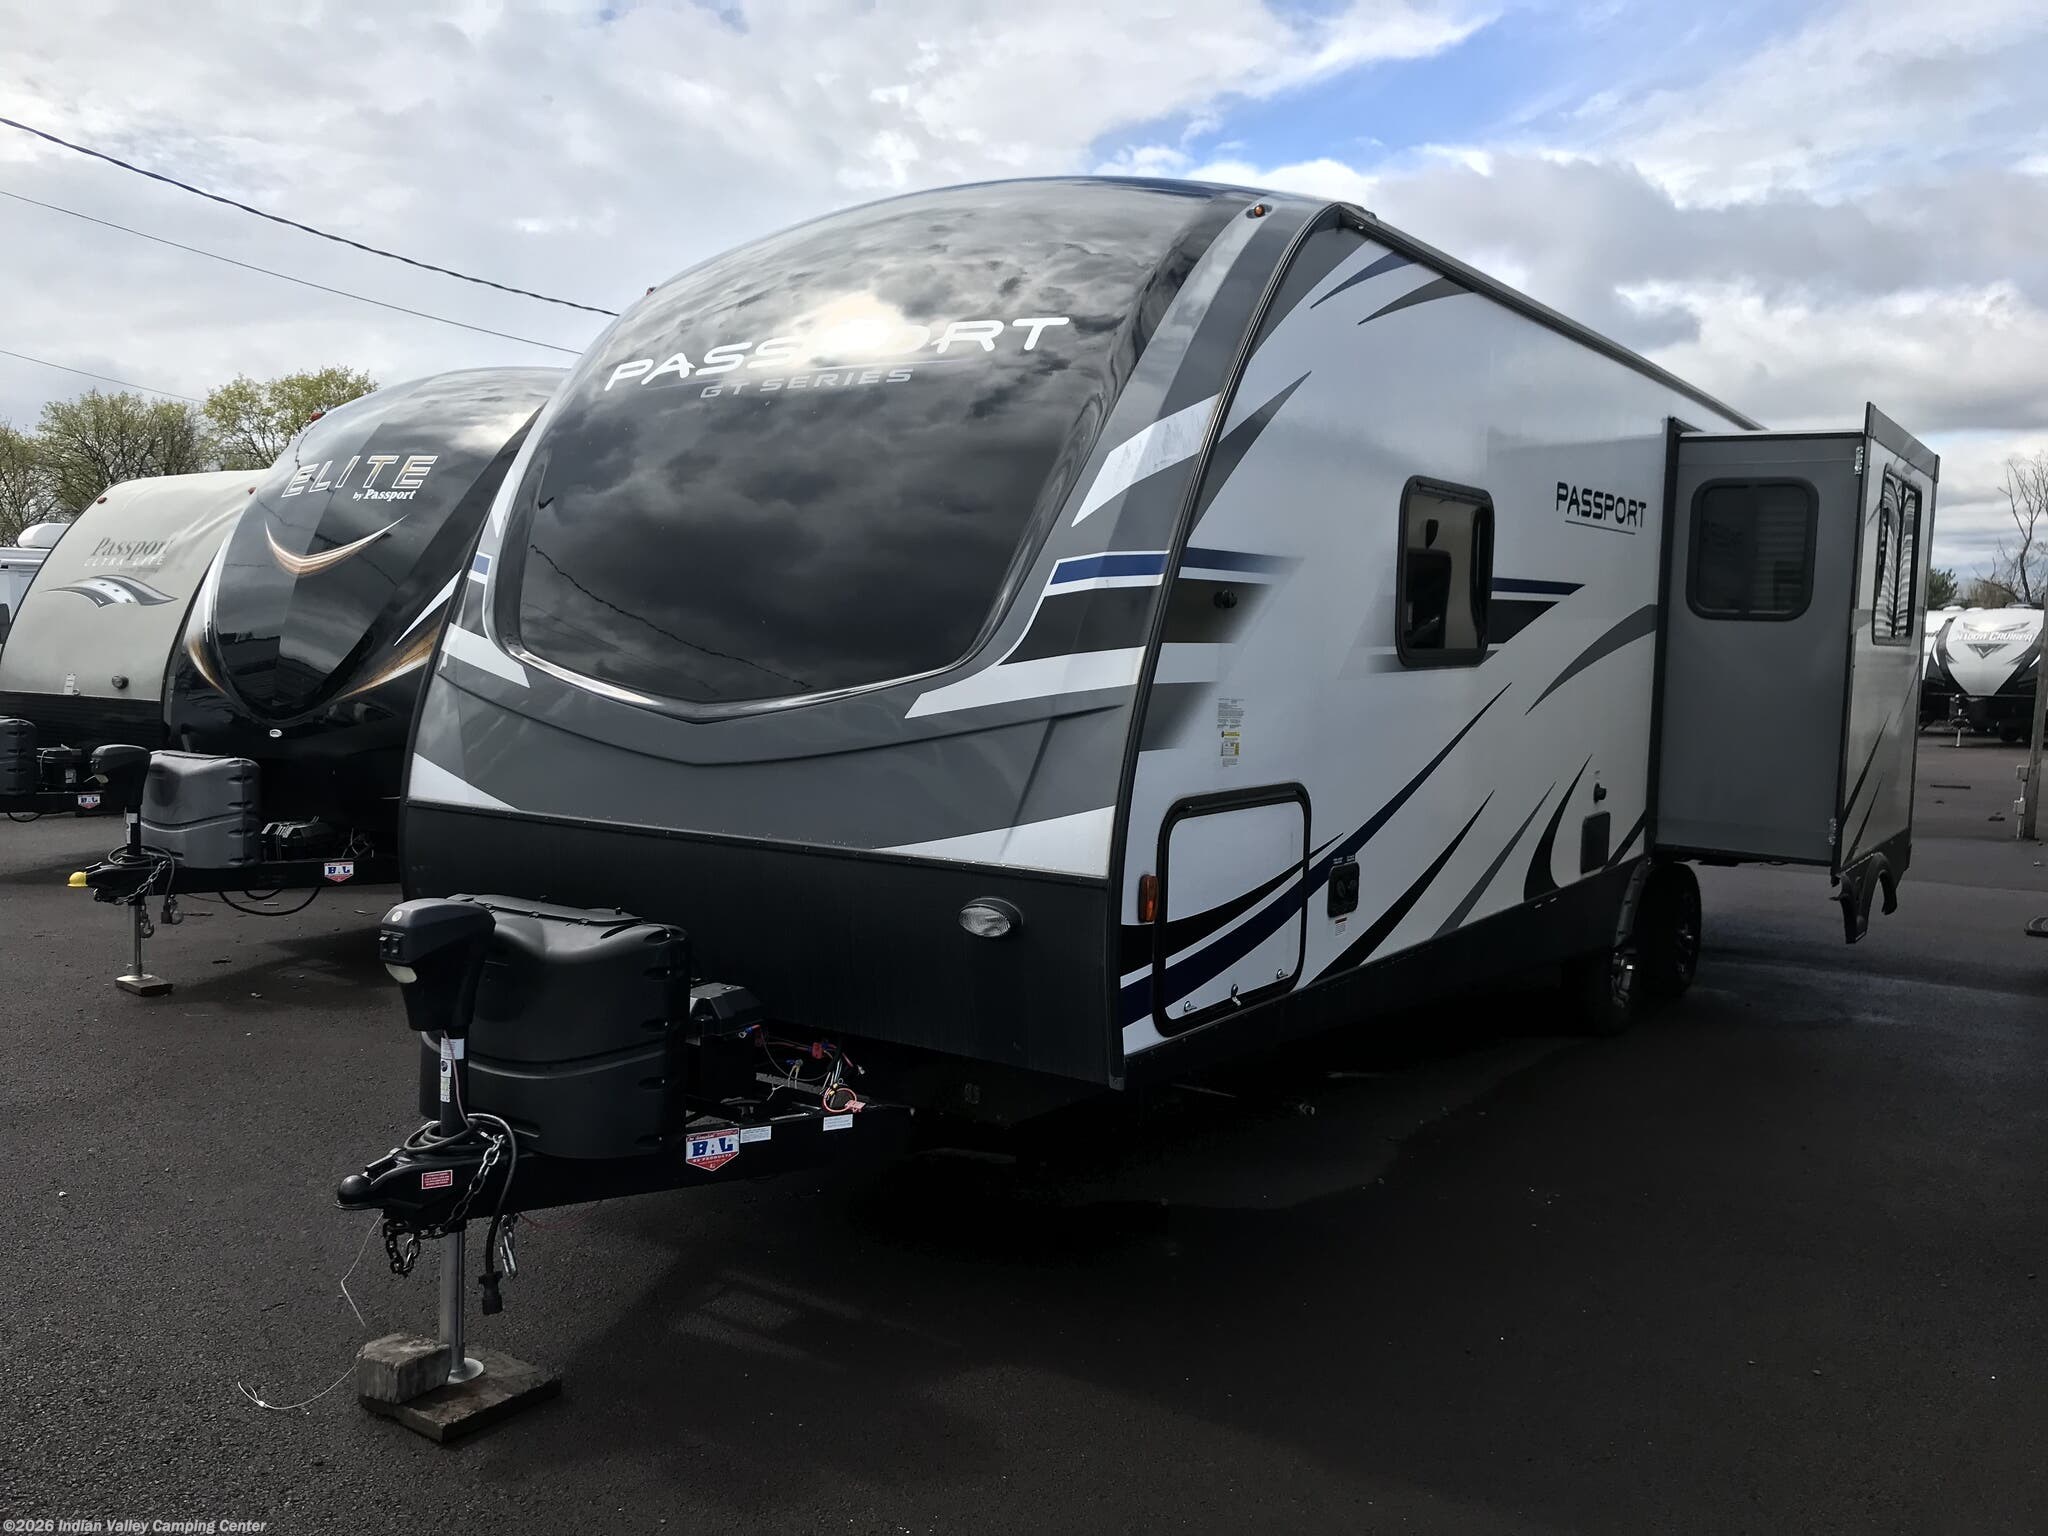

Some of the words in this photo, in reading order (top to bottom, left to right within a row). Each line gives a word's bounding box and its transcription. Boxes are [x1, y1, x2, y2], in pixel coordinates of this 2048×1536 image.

[605, 316, 1070, 391] PASSORT
[701, 382, 749, 399] GT
[760, 368, 914, 392] SERIES
[281, 455, 438, 498] ELITE
[353, 492, 363, 501] by
[363, 489, 416, 501] Passport
[1556, 481, 1647, 528] PASSPORT
